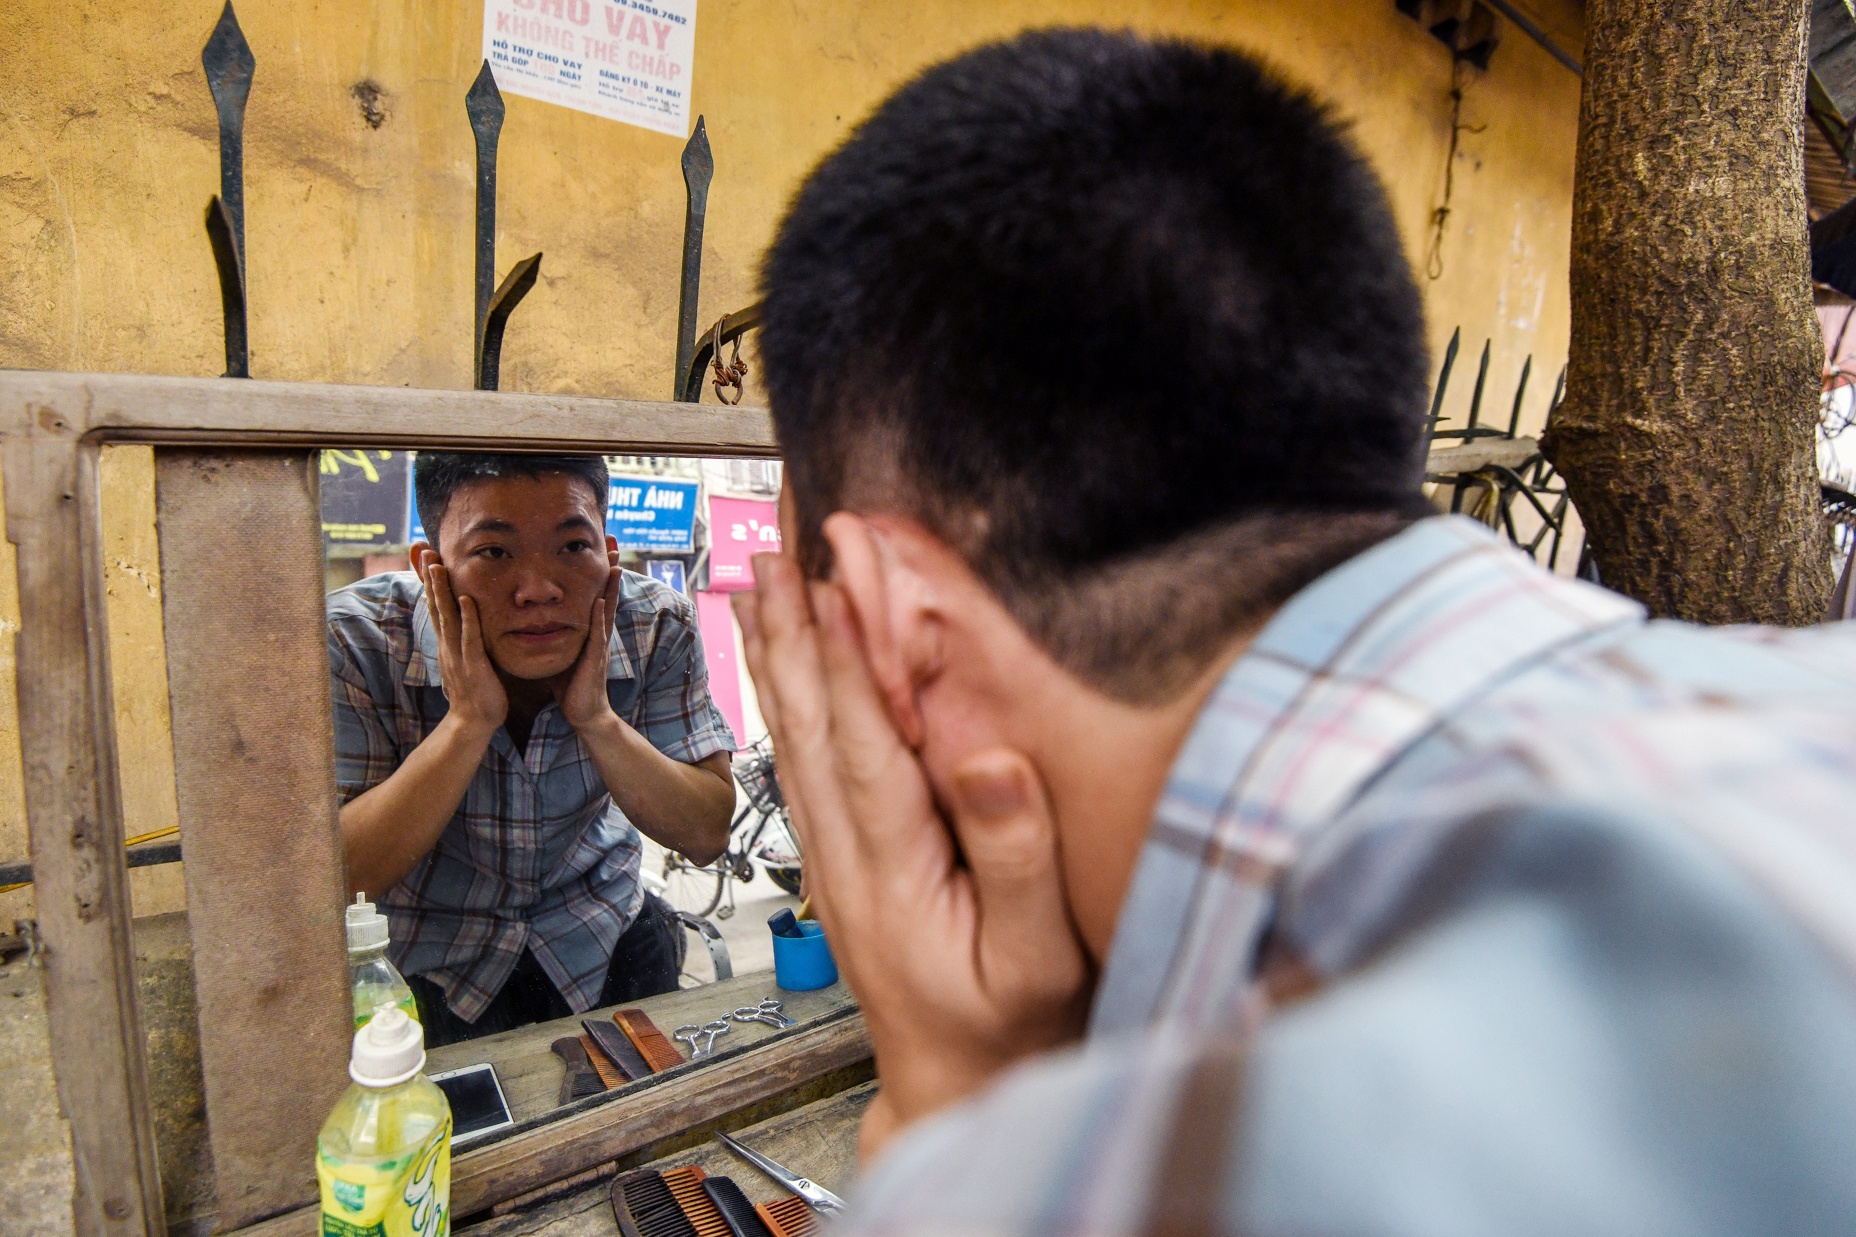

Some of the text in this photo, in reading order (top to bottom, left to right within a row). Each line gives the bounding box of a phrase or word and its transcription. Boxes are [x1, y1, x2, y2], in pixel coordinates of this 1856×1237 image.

[605, 5, 672, 50] VAY
[496, 11, 682, 82] KHÔNG THẾ CHẤP
[512, 44, 534, 56] TRỢ
[537, 51, 559, 64] CHO
[563, 58, 583, 70] VAY
[511, 56, 529, 66] GÓP
[666, 88, 682, 98] MÁY
